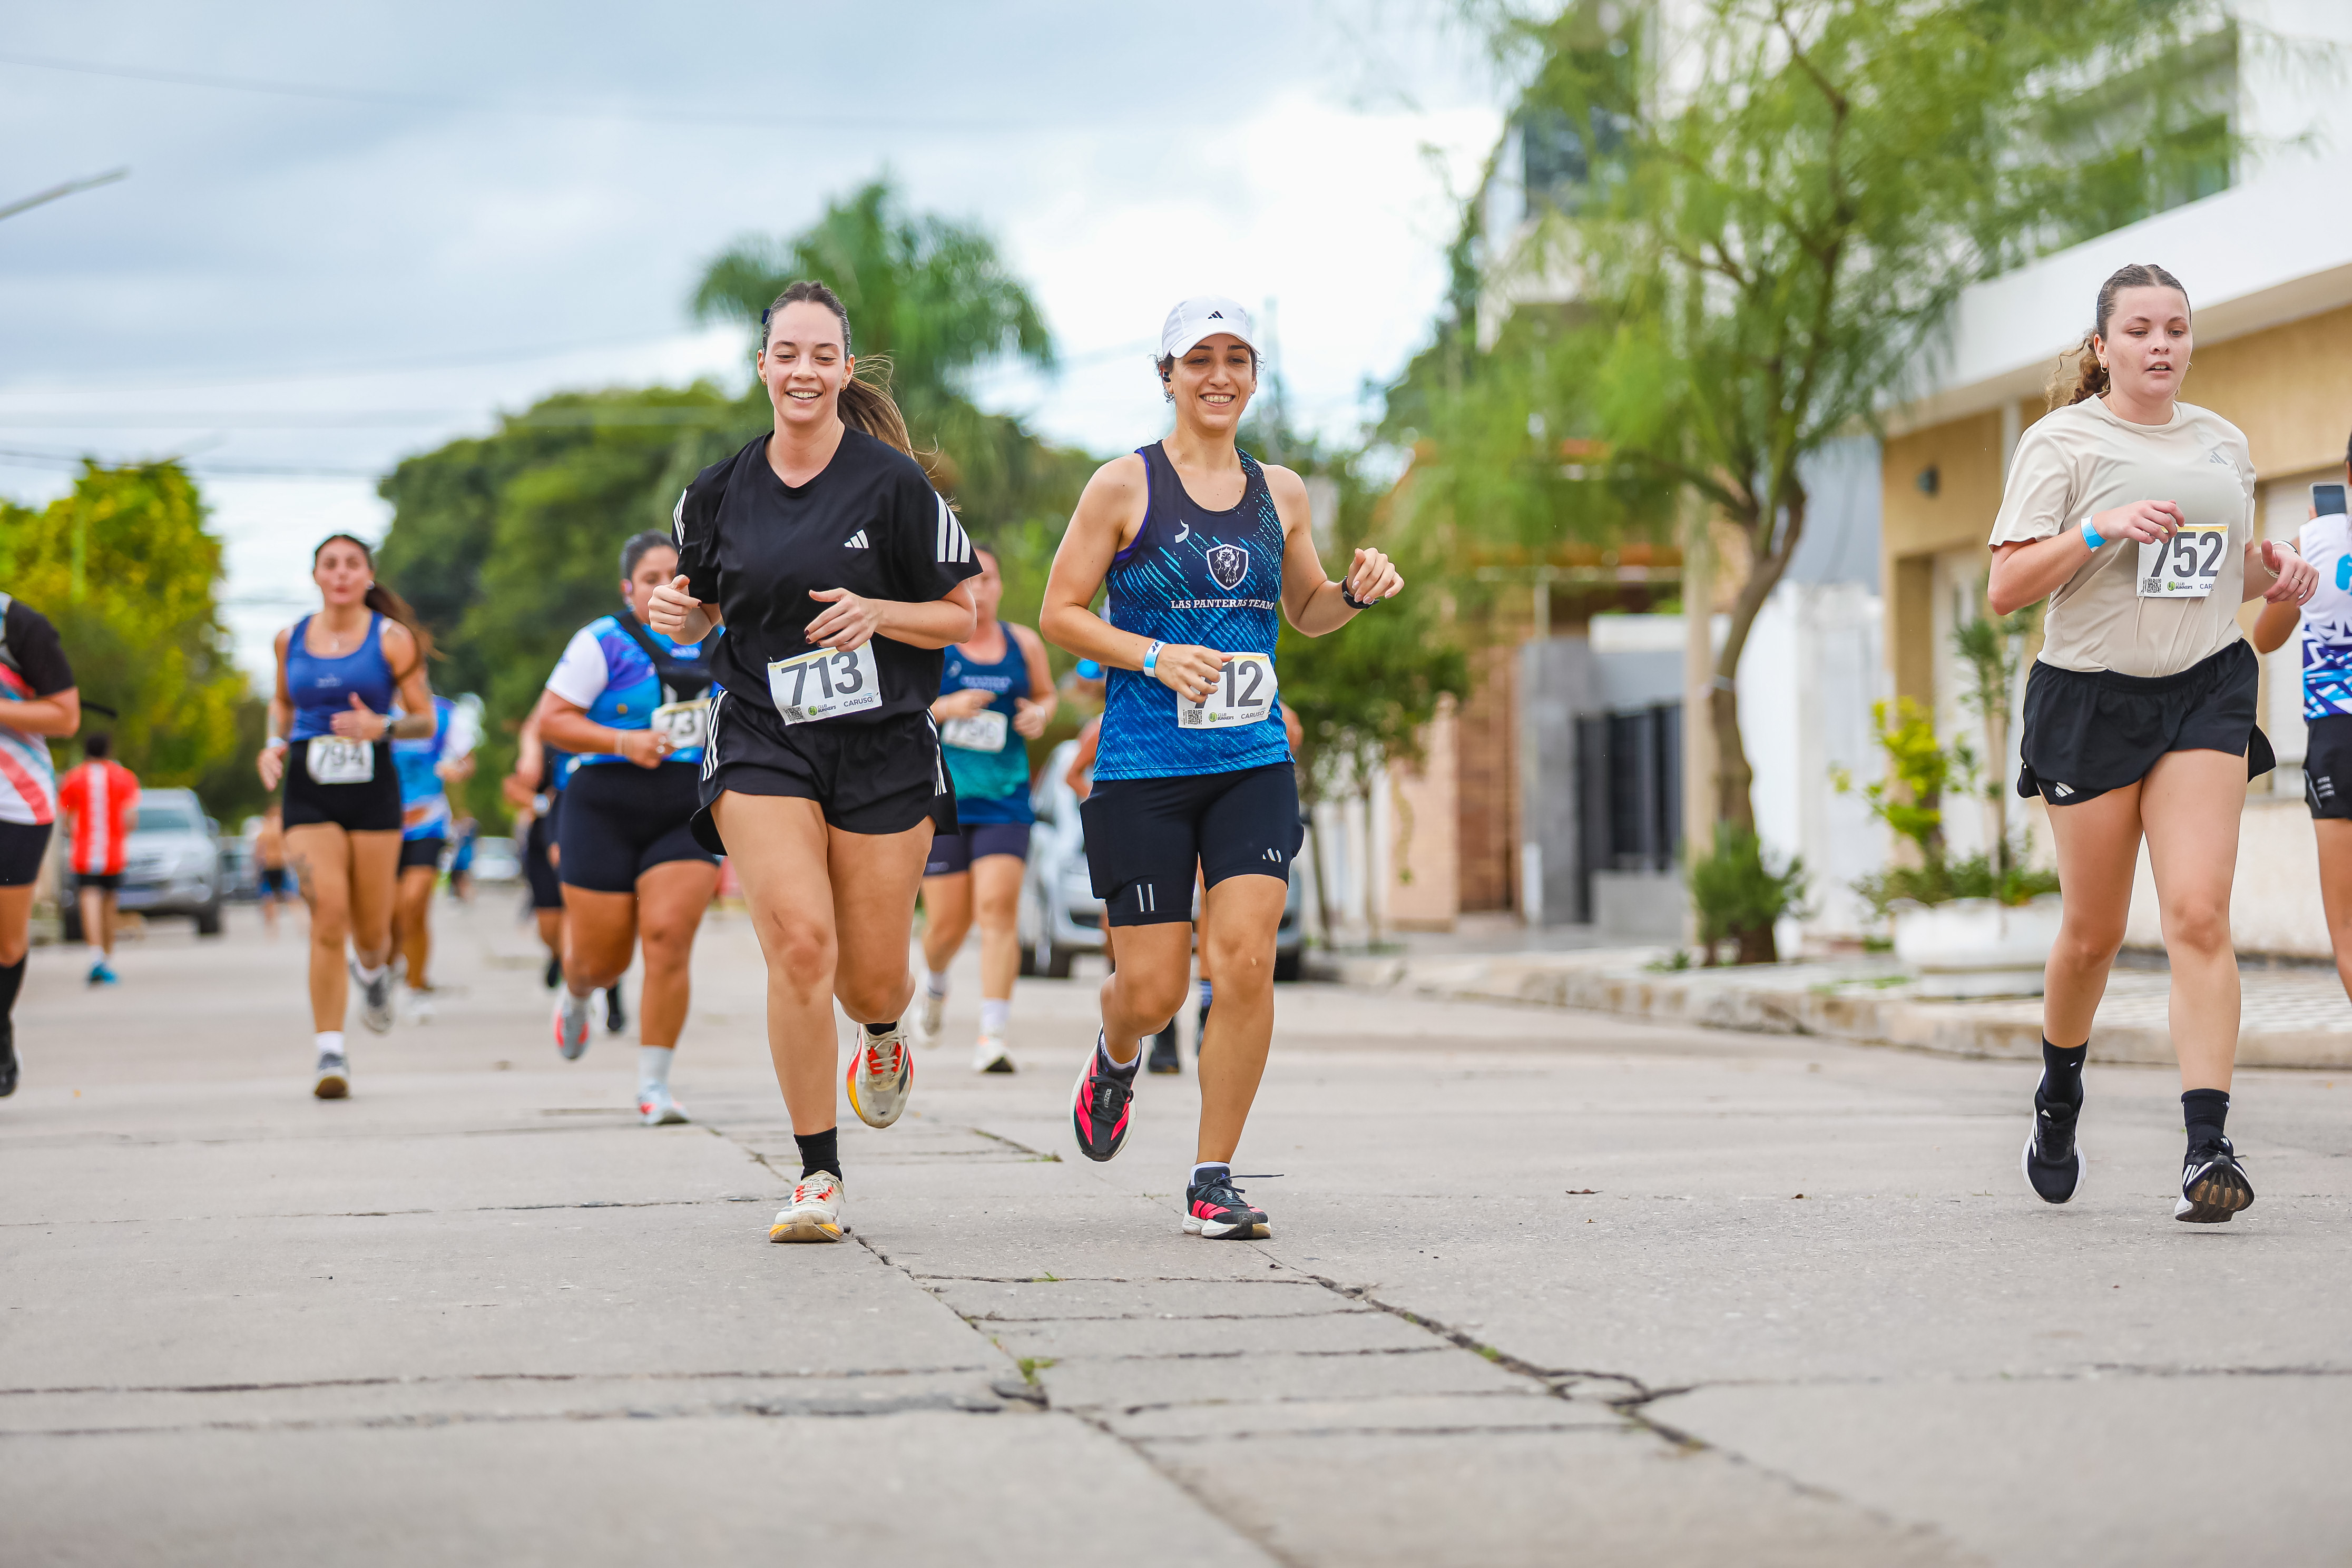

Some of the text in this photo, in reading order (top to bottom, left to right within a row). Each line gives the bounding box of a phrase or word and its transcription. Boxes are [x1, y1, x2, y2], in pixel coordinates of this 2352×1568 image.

[2149, 531, 2223, 577] 752
[1170, 599, 1275, 610] LAS PANTERAS TEAM
[781, 651, 863, 707] 713
[1194, 660, 1263, 709] 12
[843, 697, 873, 707] CARUSO
[1241, 711, 1265, 719] CARUSO
